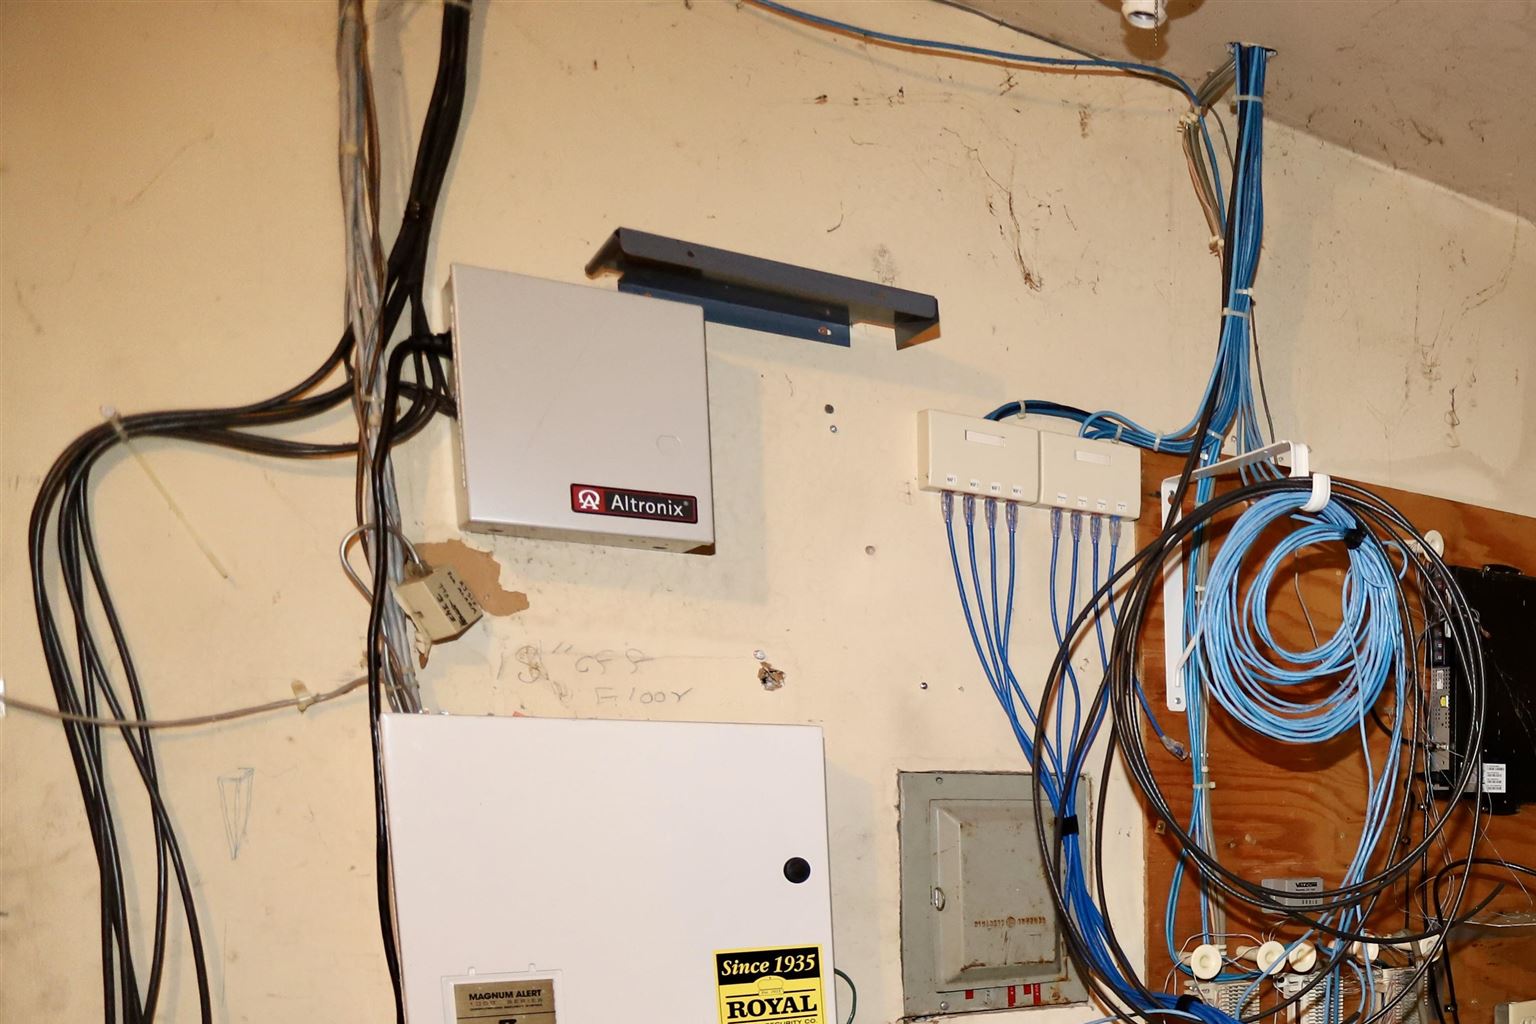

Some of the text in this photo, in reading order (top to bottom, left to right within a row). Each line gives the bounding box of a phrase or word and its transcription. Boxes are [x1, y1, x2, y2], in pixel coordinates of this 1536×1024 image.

[611, 494, 684, 517] Altronix
[721, 954, 816, 977] Since 1935
[469, 989, 542, 1001] MAGNUM ALERT
[726, 995, 818, 1020] ROYAL
